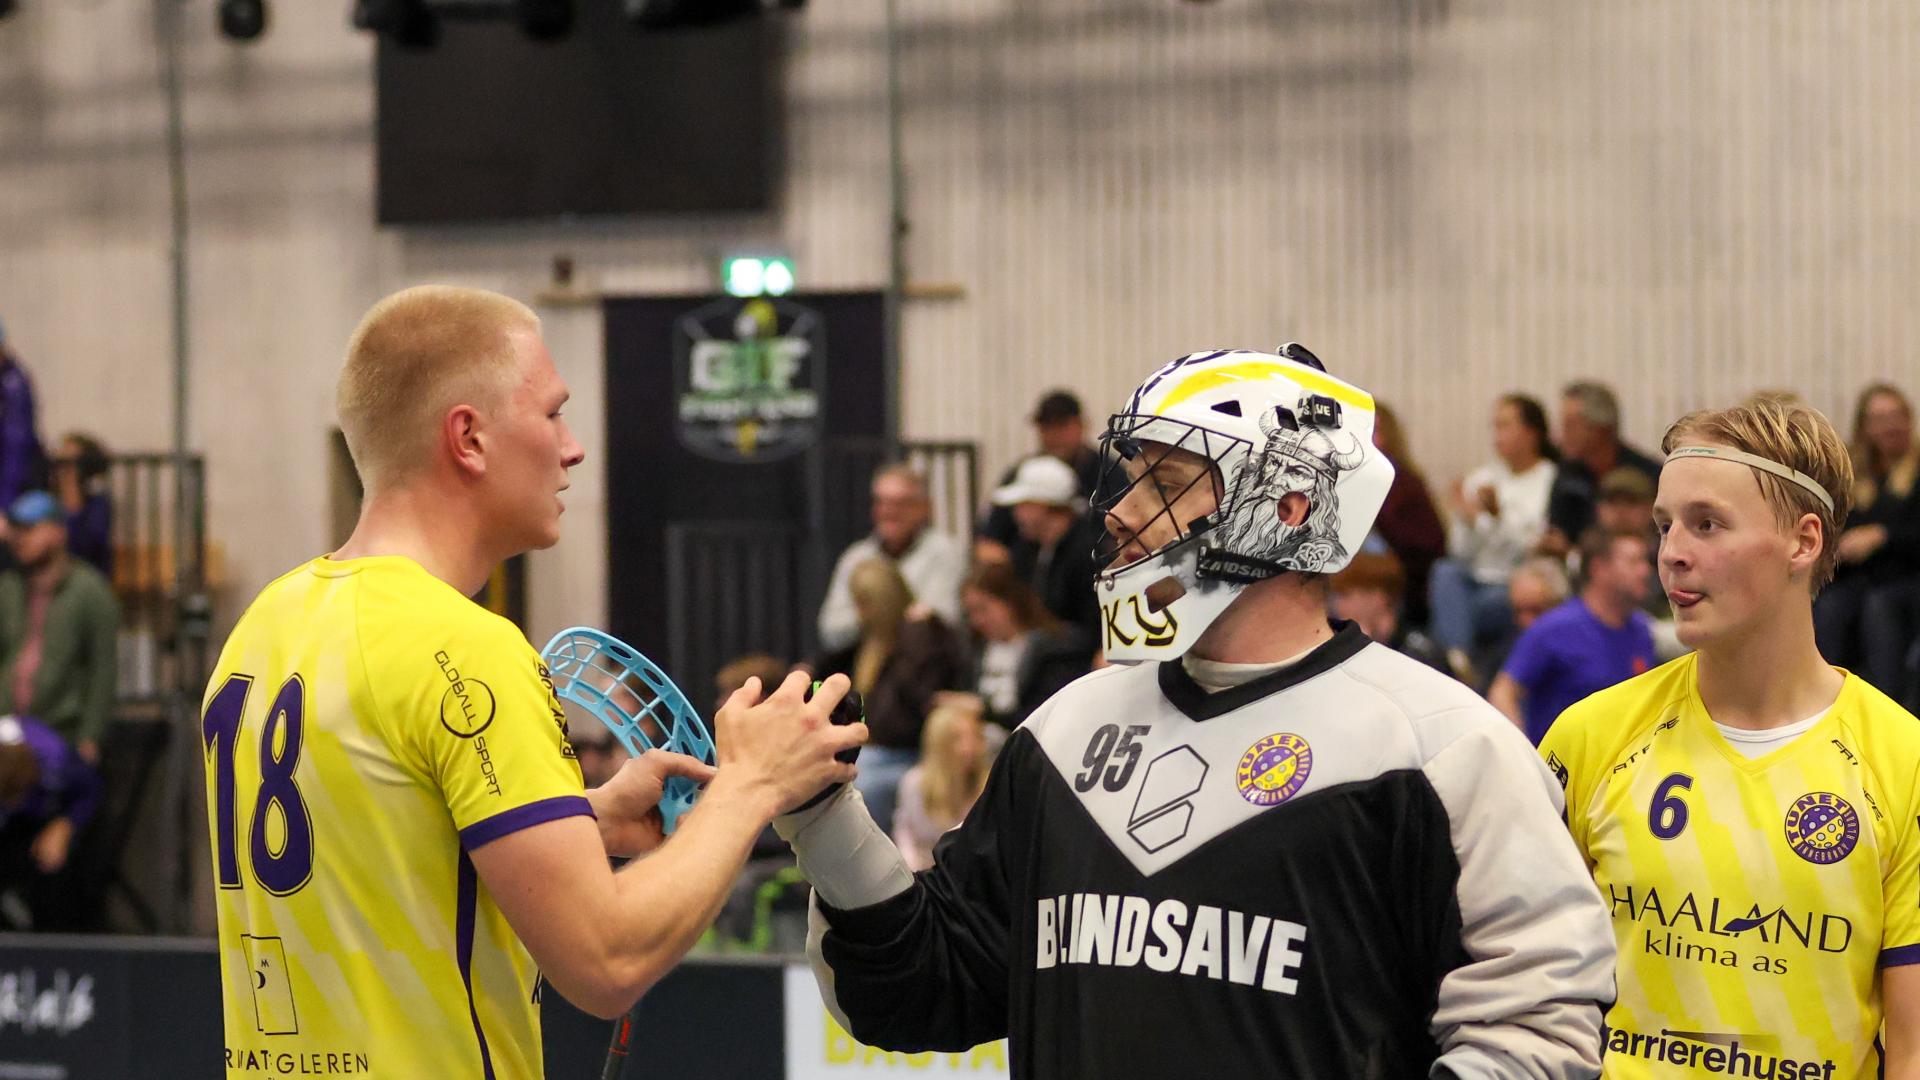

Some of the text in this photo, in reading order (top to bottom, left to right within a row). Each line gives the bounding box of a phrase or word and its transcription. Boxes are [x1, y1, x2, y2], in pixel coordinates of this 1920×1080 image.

[201, 672, 314, 898] 18
[473, 736, 502, 797] SPORT
[1074, 723, 1152, 793] 95
[1238, 734, 1307, 787] TUNET
[1648, 771, 1694, 842] 6
[1786, 793, 1848, 844] TUNET
[1036, 892, 1307, 996] BLINDSAVE
[1609, 883, 1853, 953] HAALAND
[1645, 929, 1788, 975] klima as
